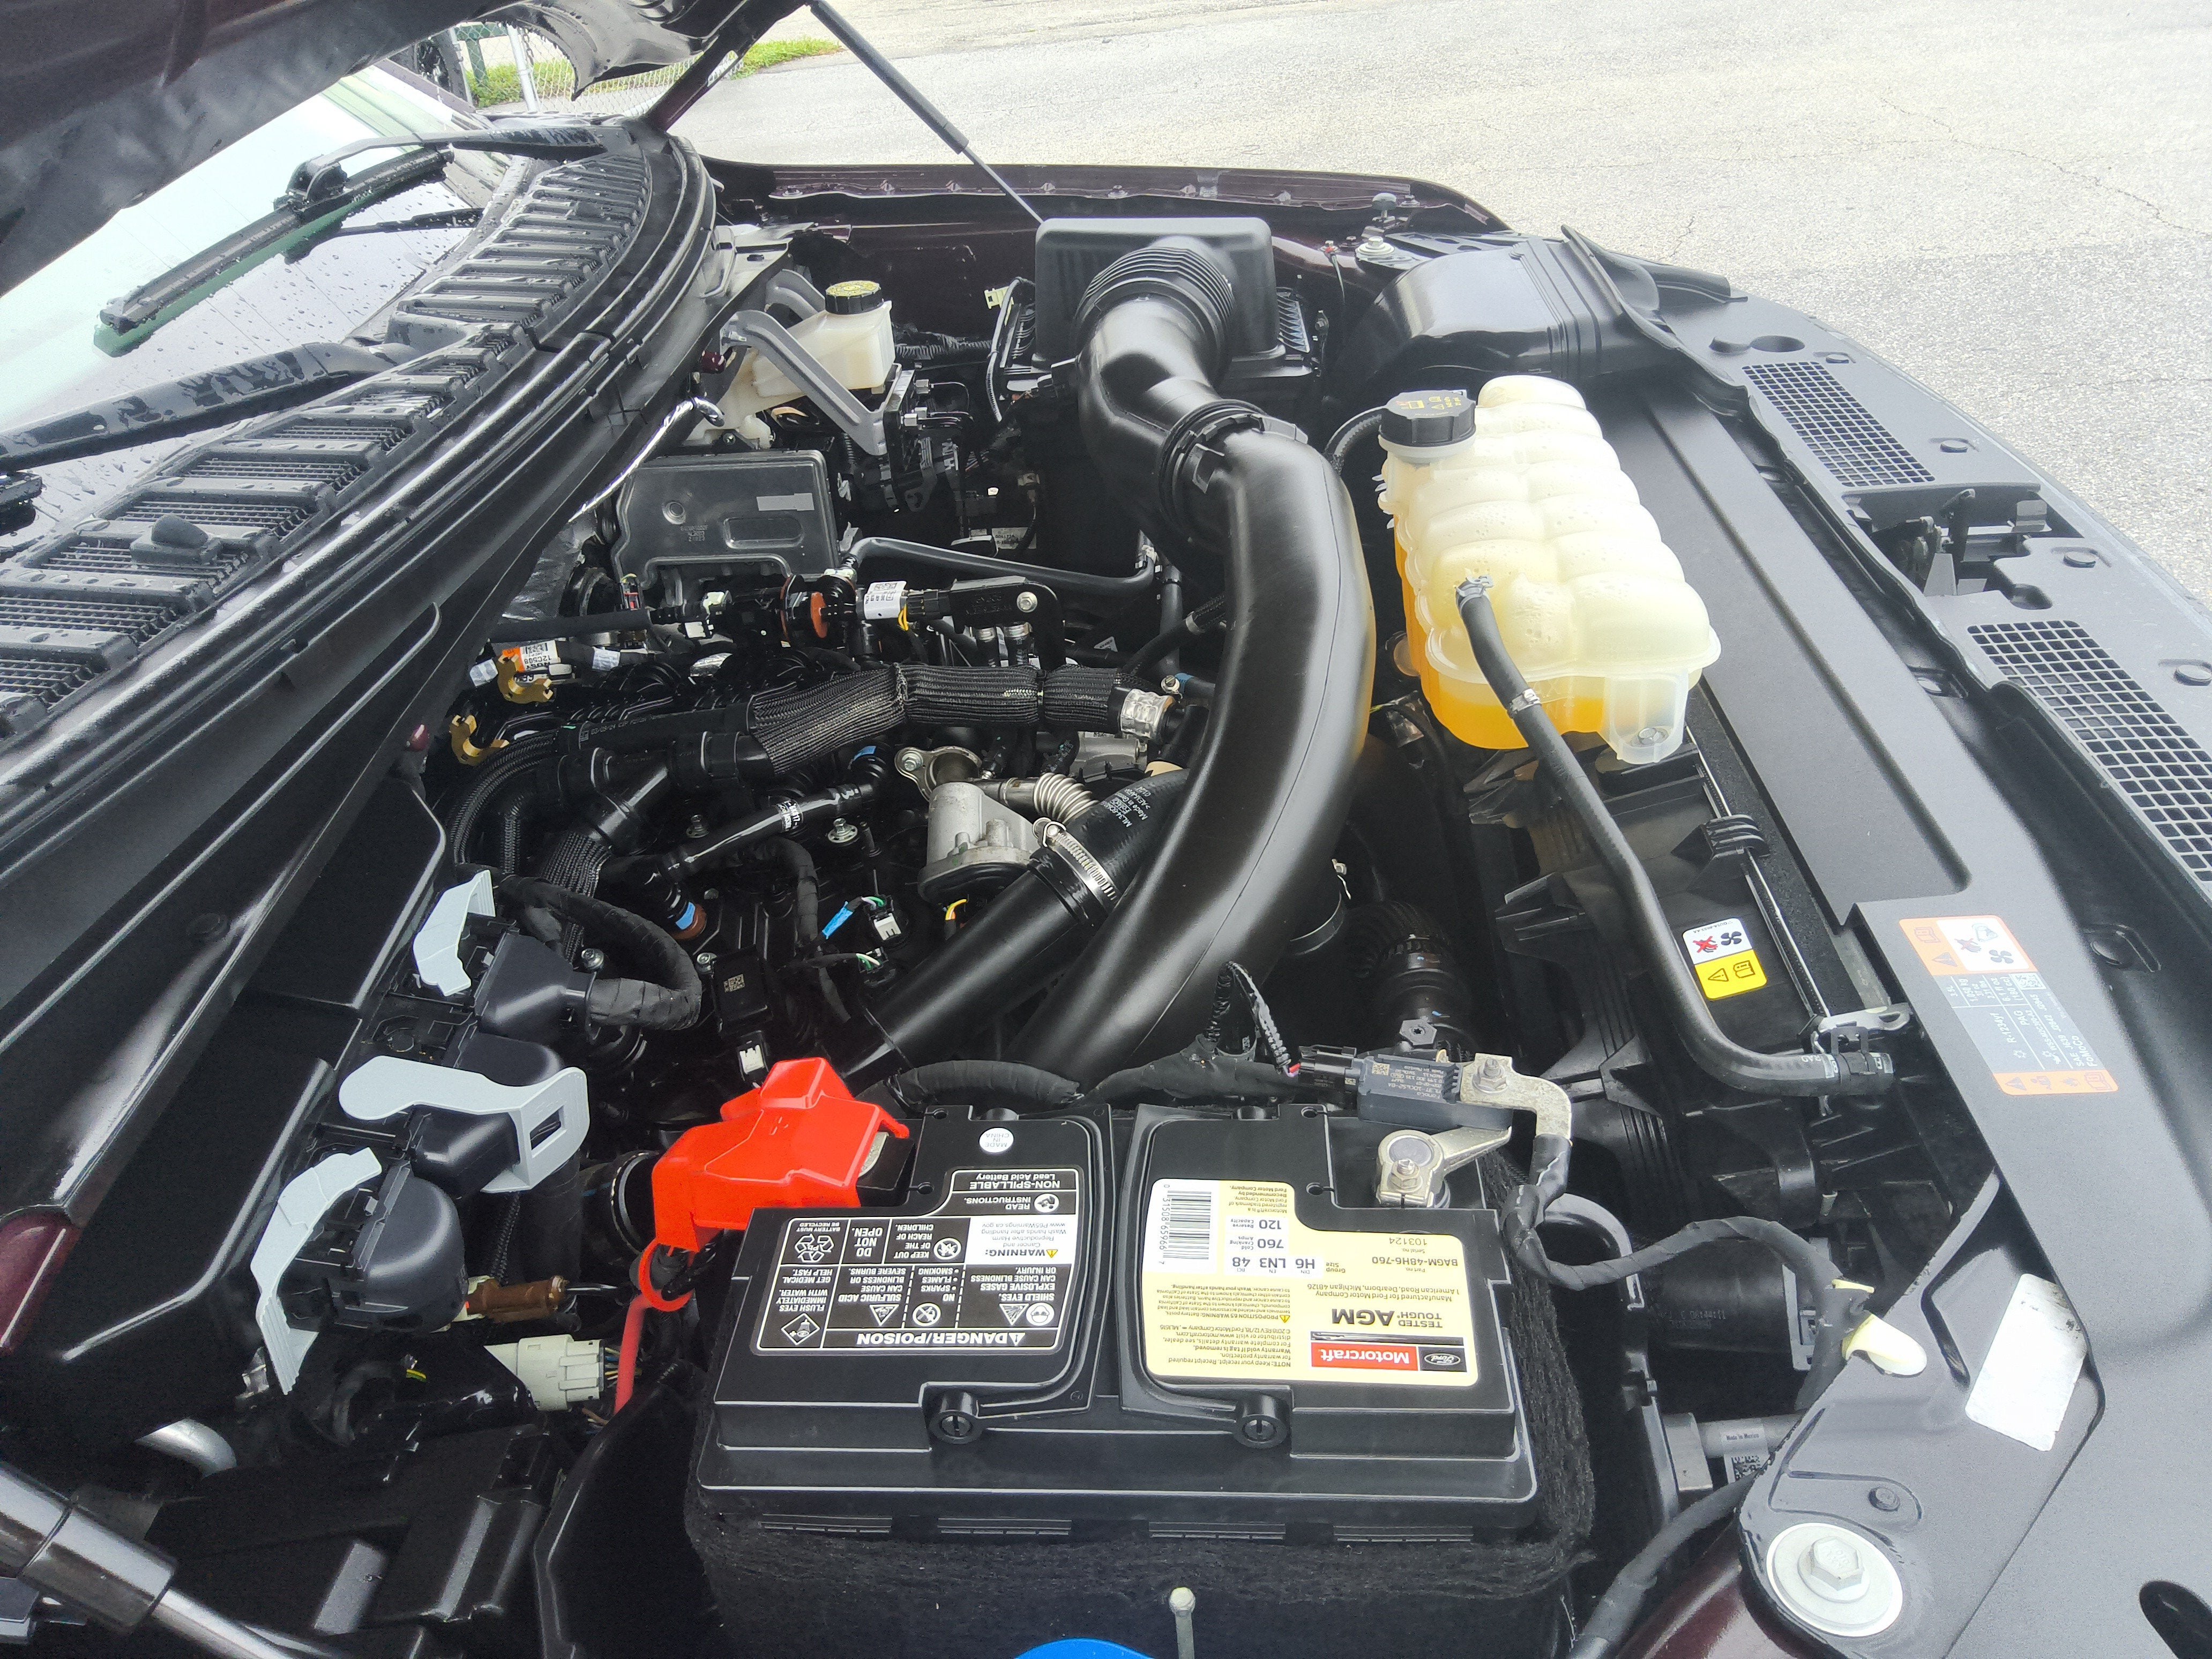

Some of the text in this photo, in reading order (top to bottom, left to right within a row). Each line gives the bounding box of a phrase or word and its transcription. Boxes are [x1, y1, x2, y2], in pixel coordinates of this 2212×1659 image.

[524, 655, 551, 664] 12C508
[2014, 1010, 2030, 1026] PAG
[2069, 1052, 2084, 1066] SAE
[969, 1180, 1060, 1189] NON-SPILLABLE
[1161, 1198, 1170, 1221] 31508
[1259, 1219, 1282, 1230] 120
[851, 1227, 883, 1237] OPEN.
[854, 1237, 877, 1246] NOT
[1159, 1225, 1168, 1250] 65966
[1389, 1237, 1428, 1245] 103124
[1257, 1238, 1284, 1248] 760
[856, 1247, 872, 1257] DO
[1232, 1257, 1315, 1269] H6 LN3 48
[1372, 1257, 1458, 1266] BAGM-48H6-760
[980, 1283, 1007, 1291] GASES
[838, 1294, 902, 1302] SULFURIC ACID
[943, 1294, 955, 1302] NO
[1025, 1293, 1055, 1301] SHIELD
[1332, 1309, 1395, 1326] AGM
[1398, 1320, 1443, 1328] TESTED
[857, 1332, 1008, 1344] DANGER/POISON
